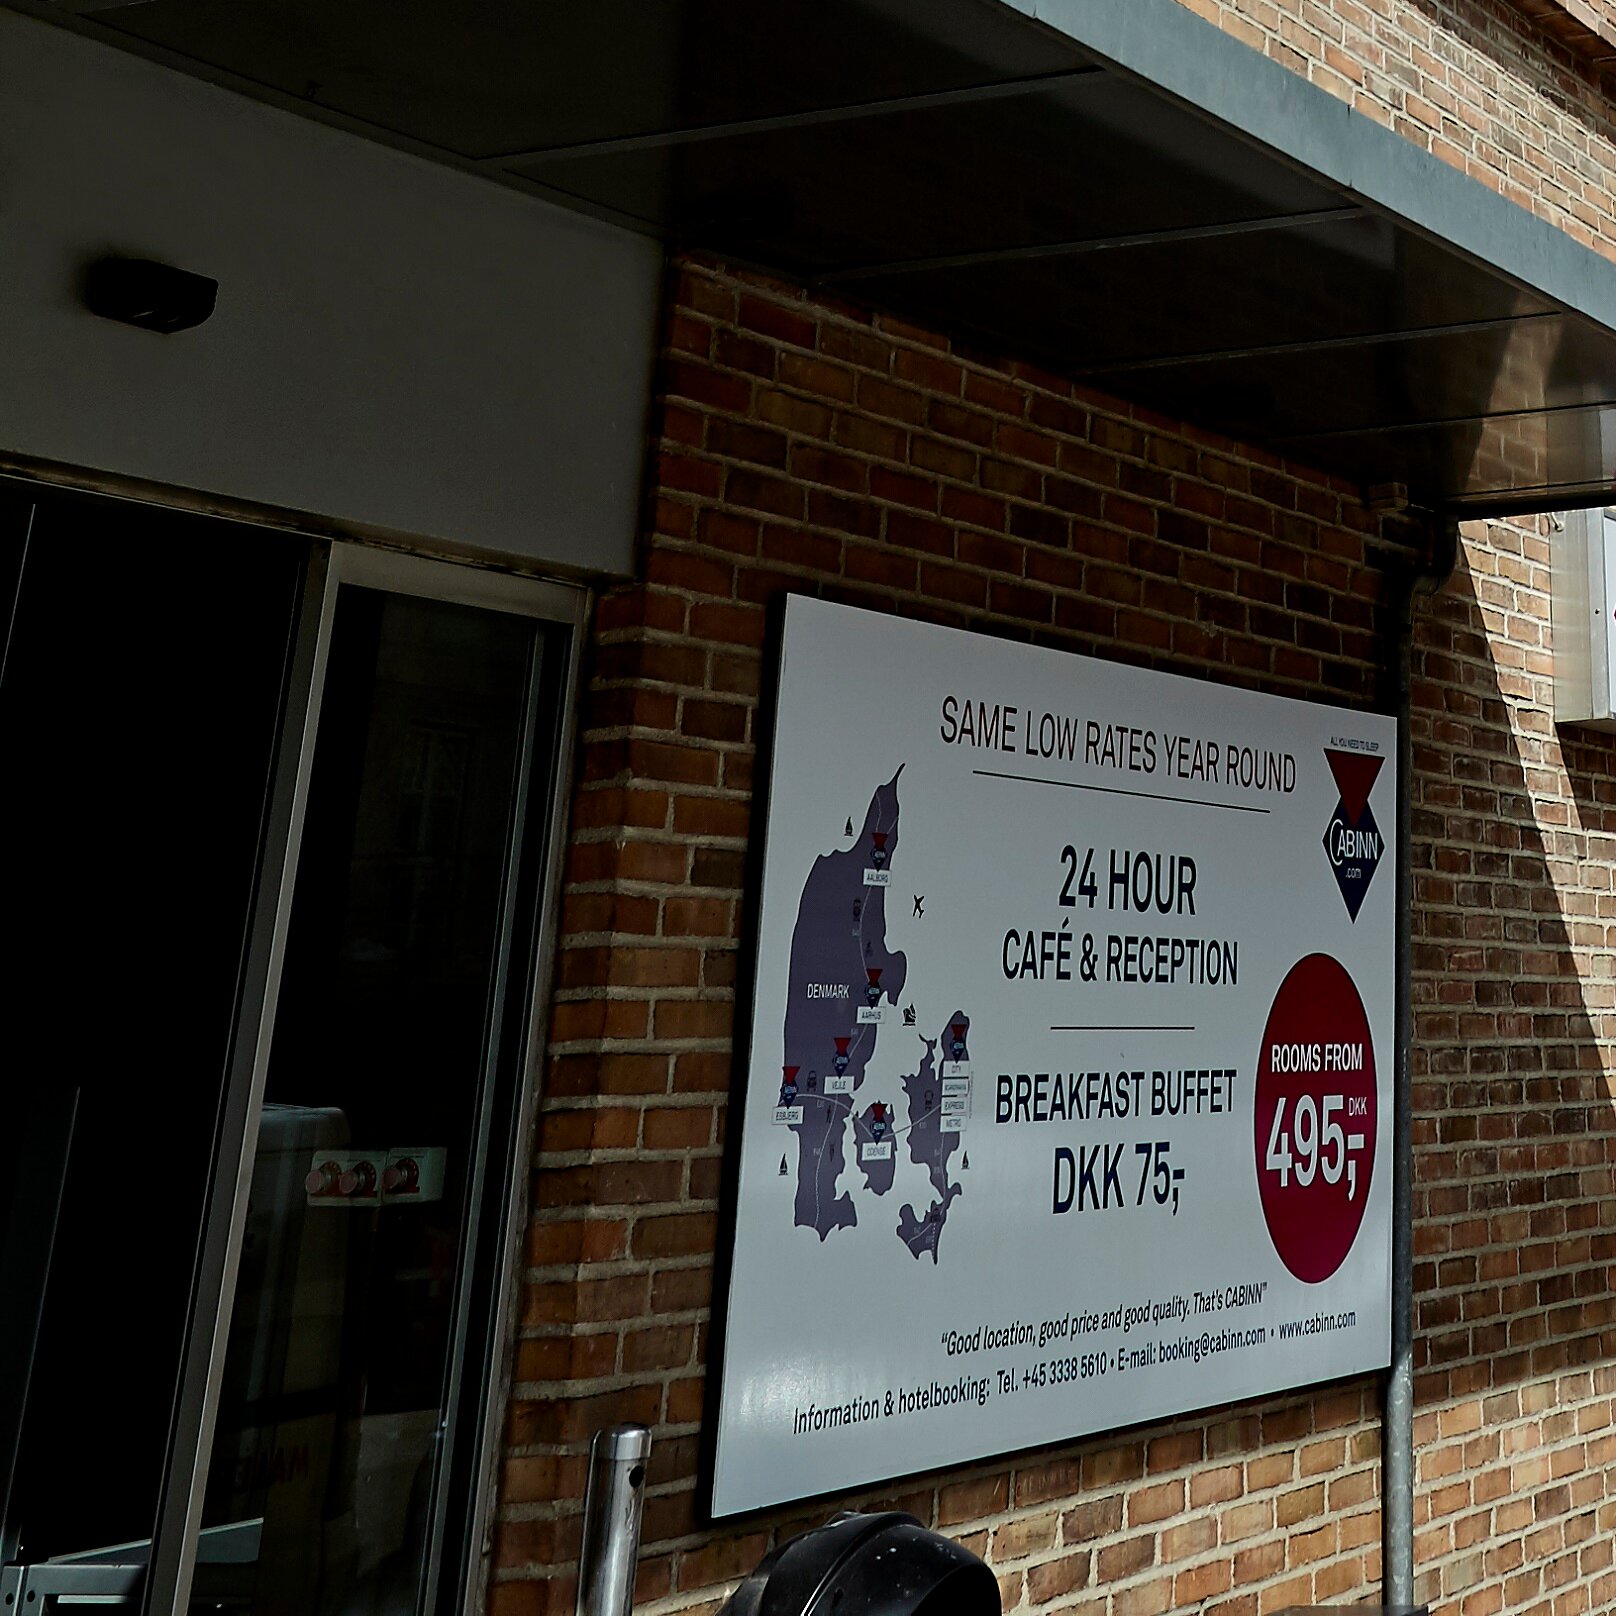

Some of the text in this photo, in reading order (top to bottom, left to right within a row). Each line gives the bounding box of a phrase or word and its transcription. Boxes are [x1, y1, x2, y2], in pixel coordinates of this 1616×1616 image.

[940, 695, 1297, 793] SAME LOW RATES YEAR ROUND
[1329, 818, 1379, 866] CABINN
[1058, 844, 1197, 915] 24 HOUR
[1002, 916, 1238, 985] CAFÉ & RECEPTION
[807, 983, 850, 999] DENMARK
[1271, 1043, 1363, 1073] ROOMS FROM
[995, 1070, 1145, 1124] BREAKFAST
[1151, 1069, 1237, 1116] BUFFET
[1348, 1096, 1367, 1116] DKK
[1052, 1143, 1125, 1215] DKK
[983, 1320, 1036, 1350] location,
[1038, 1312, 1069, 1348] good
[1070, 1309, 1099, 1341] price
[1101, 1303, 1123, 1330] and
[1123, 1299, 1151, 1333] good
[1152, 1295, 1190, 1327] quality.
[1194, 1288, 1223, 1314] That's
[793, 1310, 1356, 1435] Information & hotelbooking: Tel. +45 3338 5610 E-mail: booking@cabinn.com www.cabinn.com
